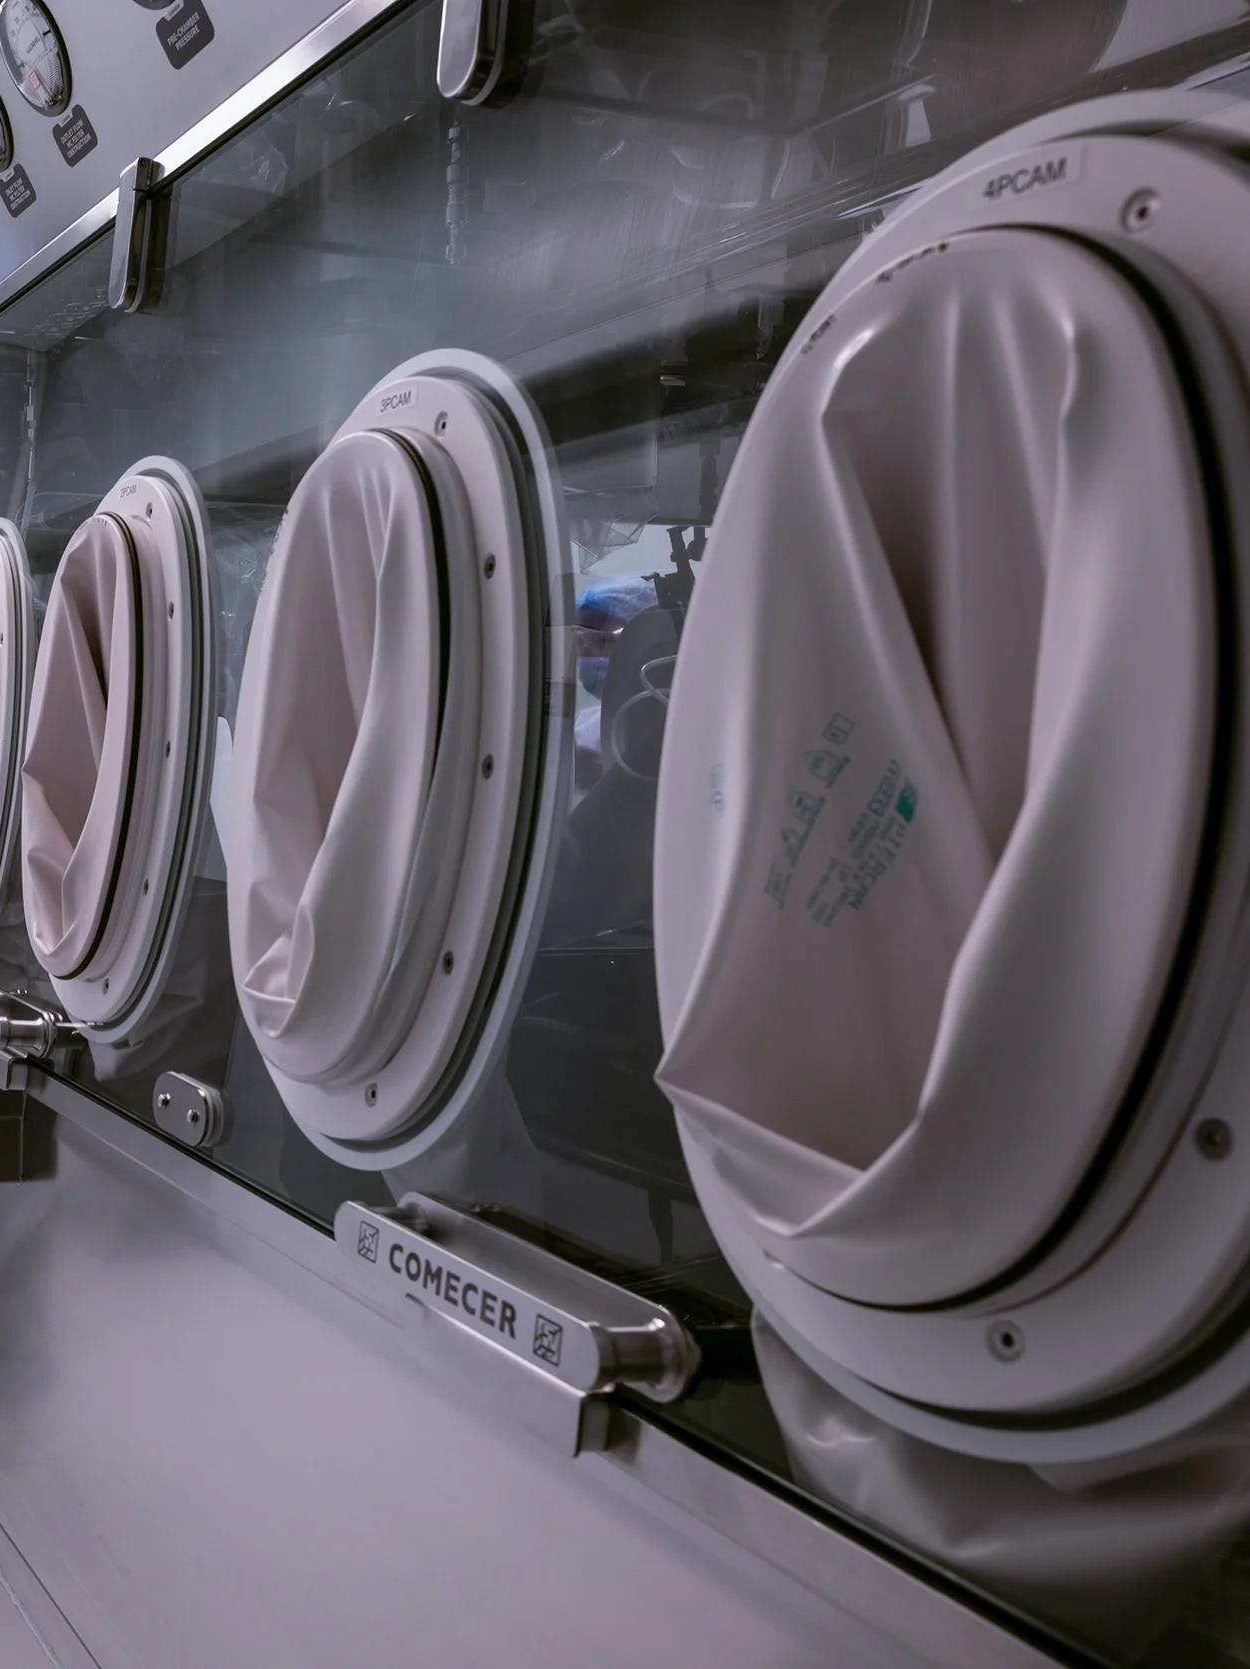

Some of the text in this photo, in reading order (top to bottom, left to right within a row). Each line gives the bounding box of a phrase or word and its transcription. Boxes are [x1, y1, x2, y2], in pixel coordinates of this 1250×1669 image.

[167, 12, 200, 46] PRE-CHAMBER
[175, 24, 200, 50] PRESSURE
[60, 128, 74, 144] OUTLET
[72, 119, 84, 132] FLOW
[72, 129, 85, 144] FILTER
[67, 133, 92, 158] OBSTRUCTION
[982, 157, 1067, 201] 4PCAM
[10, 189, 31, 210] OBSTRUCTION
[380, 391, 411, 413] 3PCAM
[389, 1243, 517, 1340] COMECER
